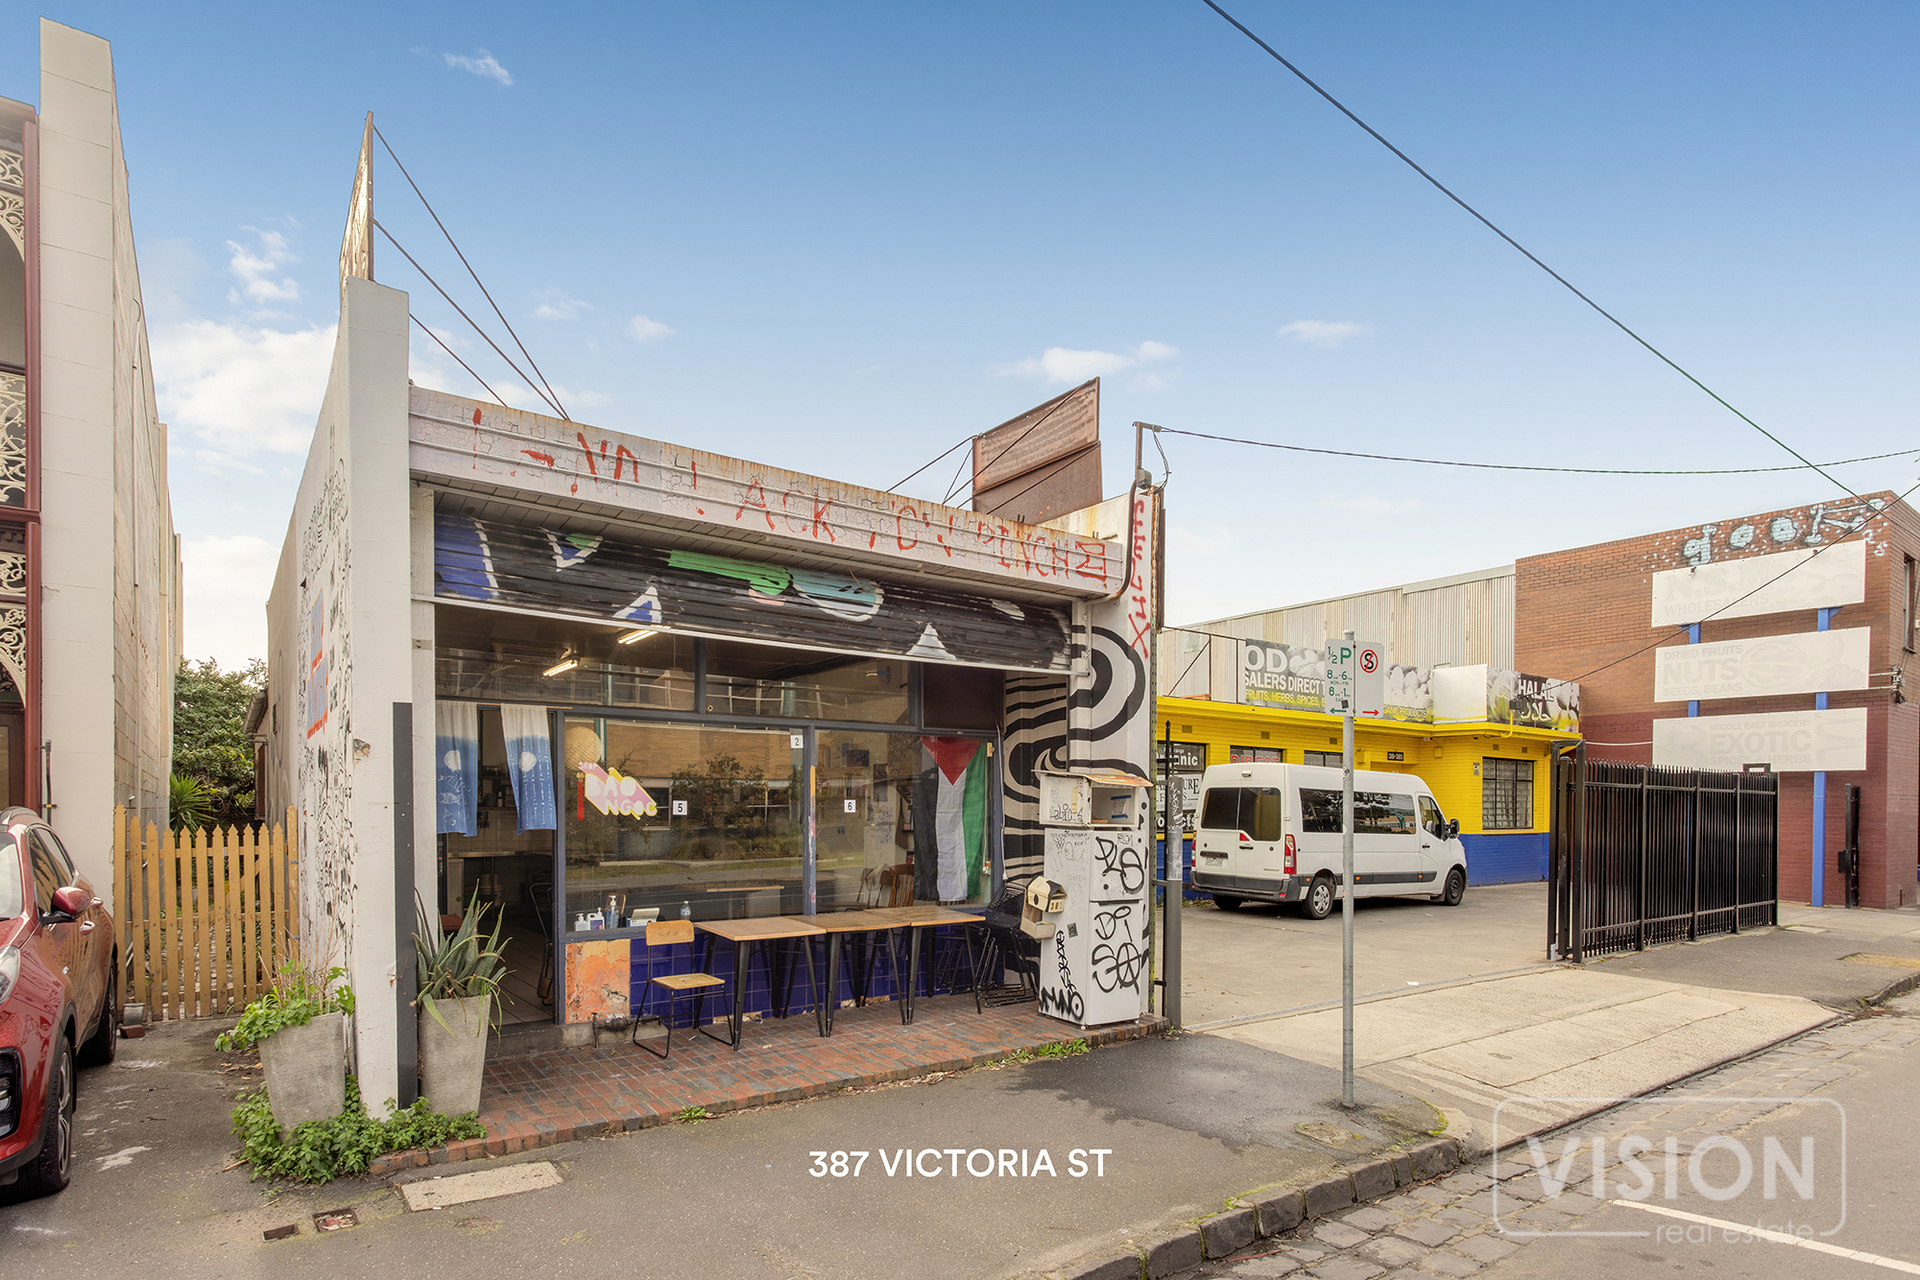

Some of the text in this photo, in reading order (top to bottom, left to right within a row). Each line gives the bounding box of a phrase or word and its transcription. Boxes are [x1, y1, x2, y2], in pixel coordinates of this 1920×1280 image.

[1664, 592, 1770, 617] WHOLESALERS
[1664, 644, 1744, 662] DRIED FRUITS
[1663, 658, 1740, 685] NUTS
[1288, 677, 1320, 695] DIRECT
[1663, 683, 1742, 697] SEEDS, BEANS
[1272, 692, 1295, 704] HERBS,
[1297, 695, 1320, 708] SPICES,
[1400, 705, 1428, 719] PRODUCTS
[1709, 719, 1812, 731] MIDDLE EAST GROCERY
[1709, 729, 1812, 754] EXOTIC
[578, 761, 598, 770] SHOP
[1709, 755, 1751, 766] SPICES
[1769, 754, 1811, 764] HERBS
